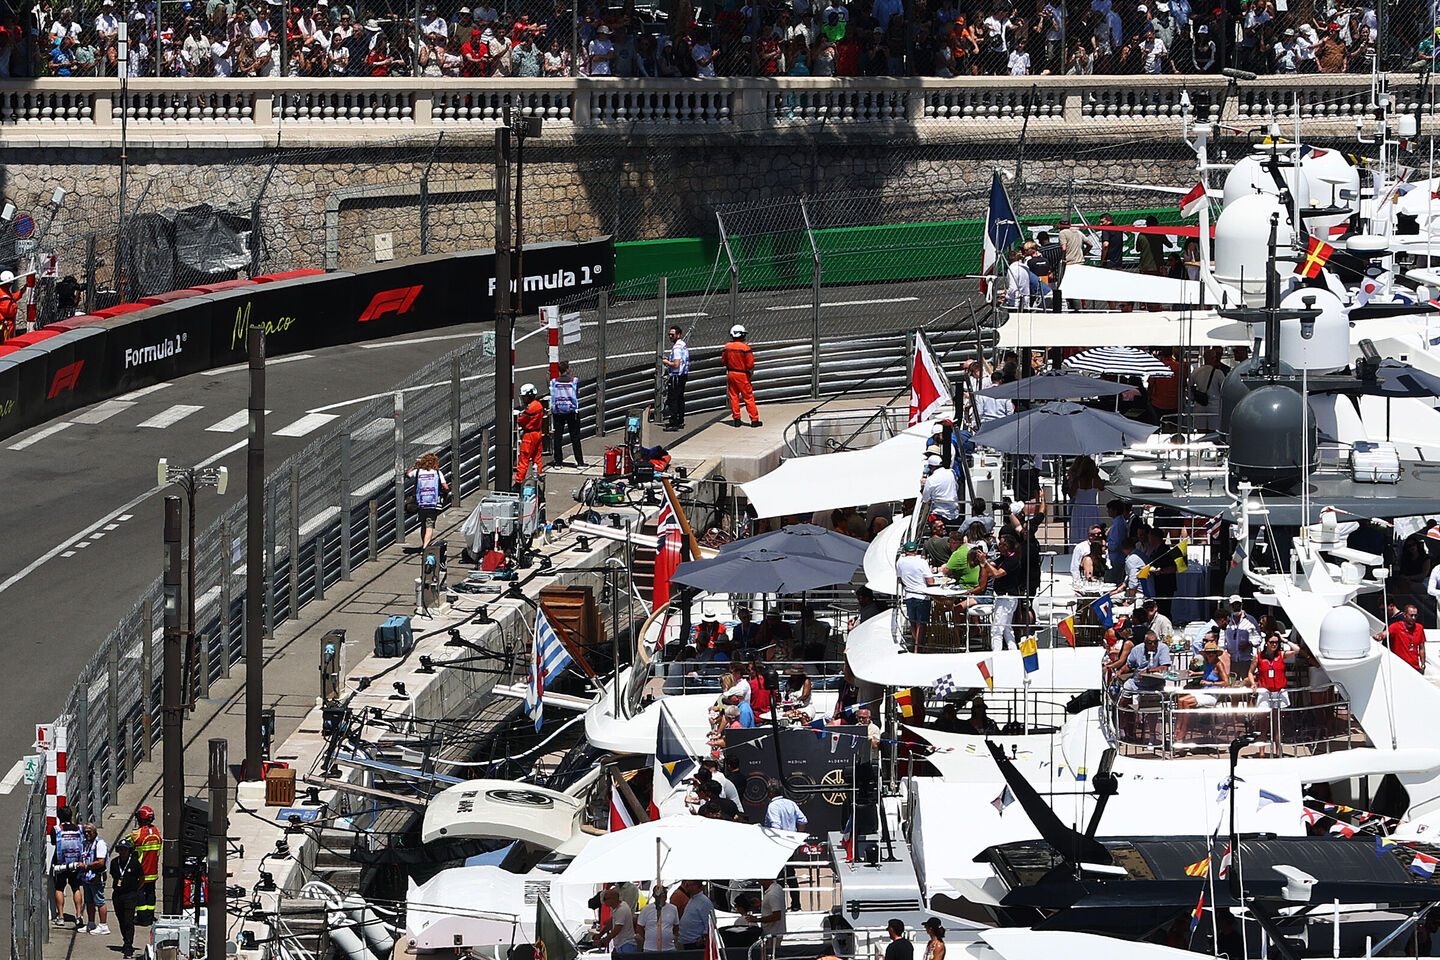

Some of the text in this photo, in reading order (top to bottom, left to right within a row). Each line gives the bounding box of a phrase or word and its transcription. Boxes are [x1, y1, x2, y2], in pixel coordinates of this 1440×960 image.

[488, 269, 576, 296] Frmula
[231, 301, 296, 352] Maco
[125, 339, 174, 369] Formula
